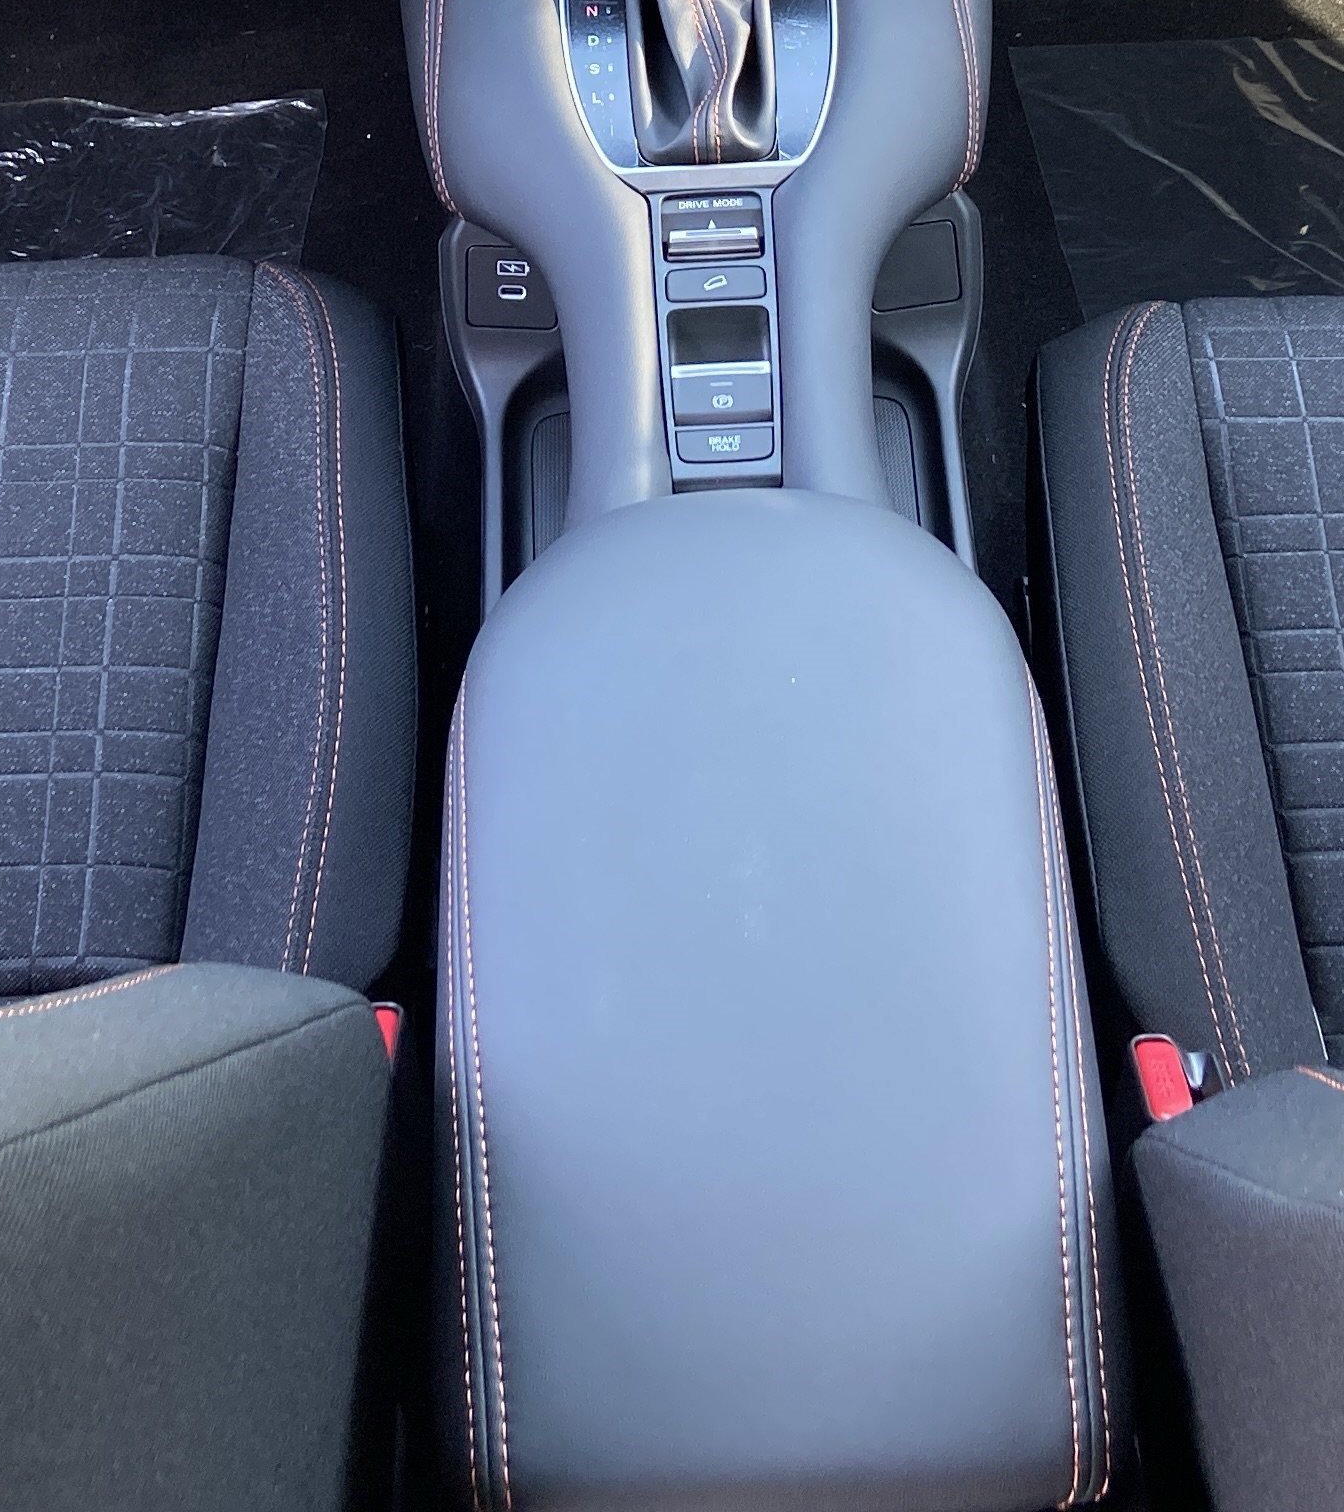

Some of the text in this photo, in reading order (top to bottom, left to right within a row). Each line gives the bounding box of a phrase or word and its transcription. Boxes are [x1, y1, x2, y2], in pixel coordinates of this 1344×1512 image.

[586, 6, 598, 17] N
[587, 35, 599, 47] D
[589, 63, 600, 75] S
[592, 92, 602, 104] L
[678, 198, 743, 209] DRIVE MODE
[708, 435, 741, 445] BRAKE
[711, 442, 740, 452] HOLD
